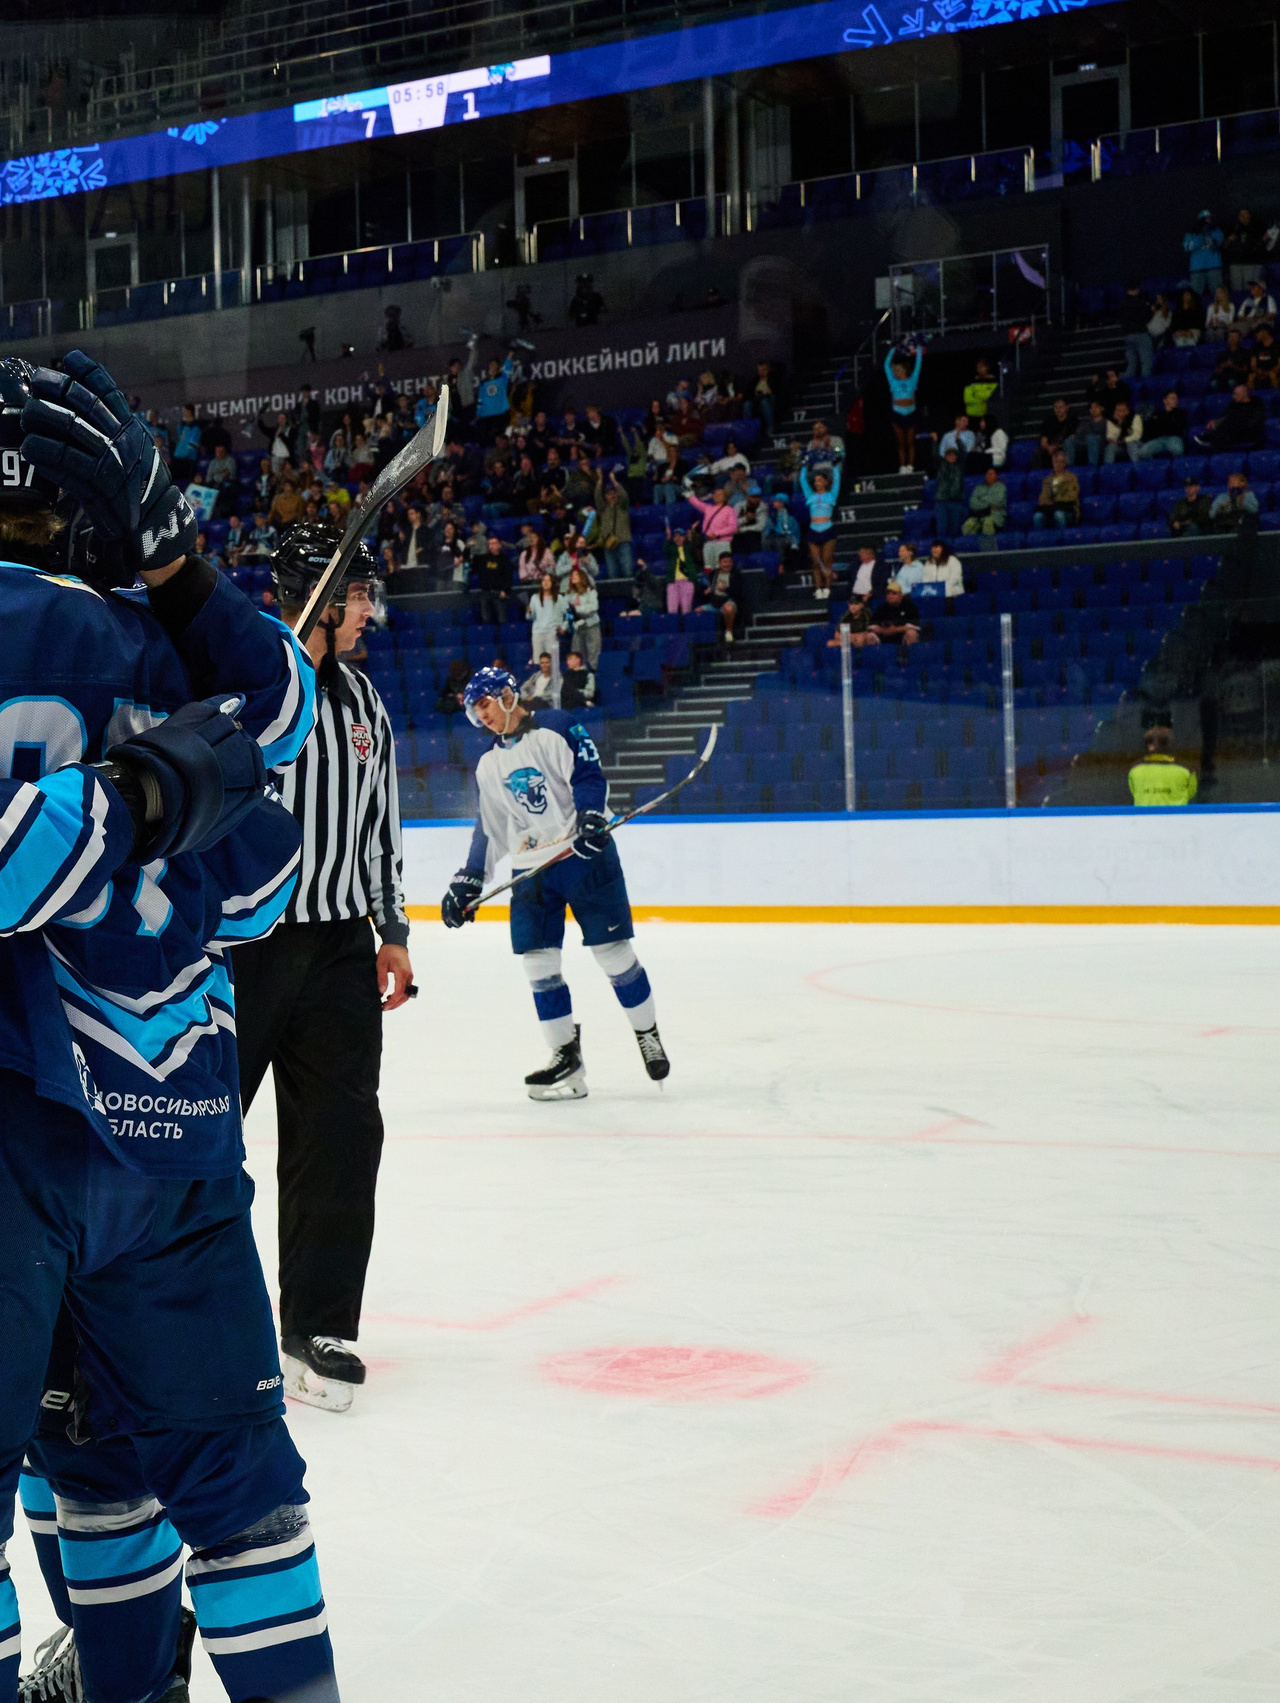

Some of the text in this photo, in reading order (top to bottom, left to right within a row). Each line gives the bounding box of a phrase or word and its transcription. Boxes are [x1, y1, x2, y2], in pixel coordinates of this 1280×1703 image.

[362, 82, 480, 138] 7 05:58 1
[206, 390, 319, 418] ЧЕМПИОНТ
[530, 342, 660, 381] ХОККЕЙНОЙ
[666, 338, 726, 364] ЛИГИ
[99, 1091, 230, 1117] ОВОСИБИРСКАЯ
[108, 1119, 184, 1140] БЛАСТЬ
